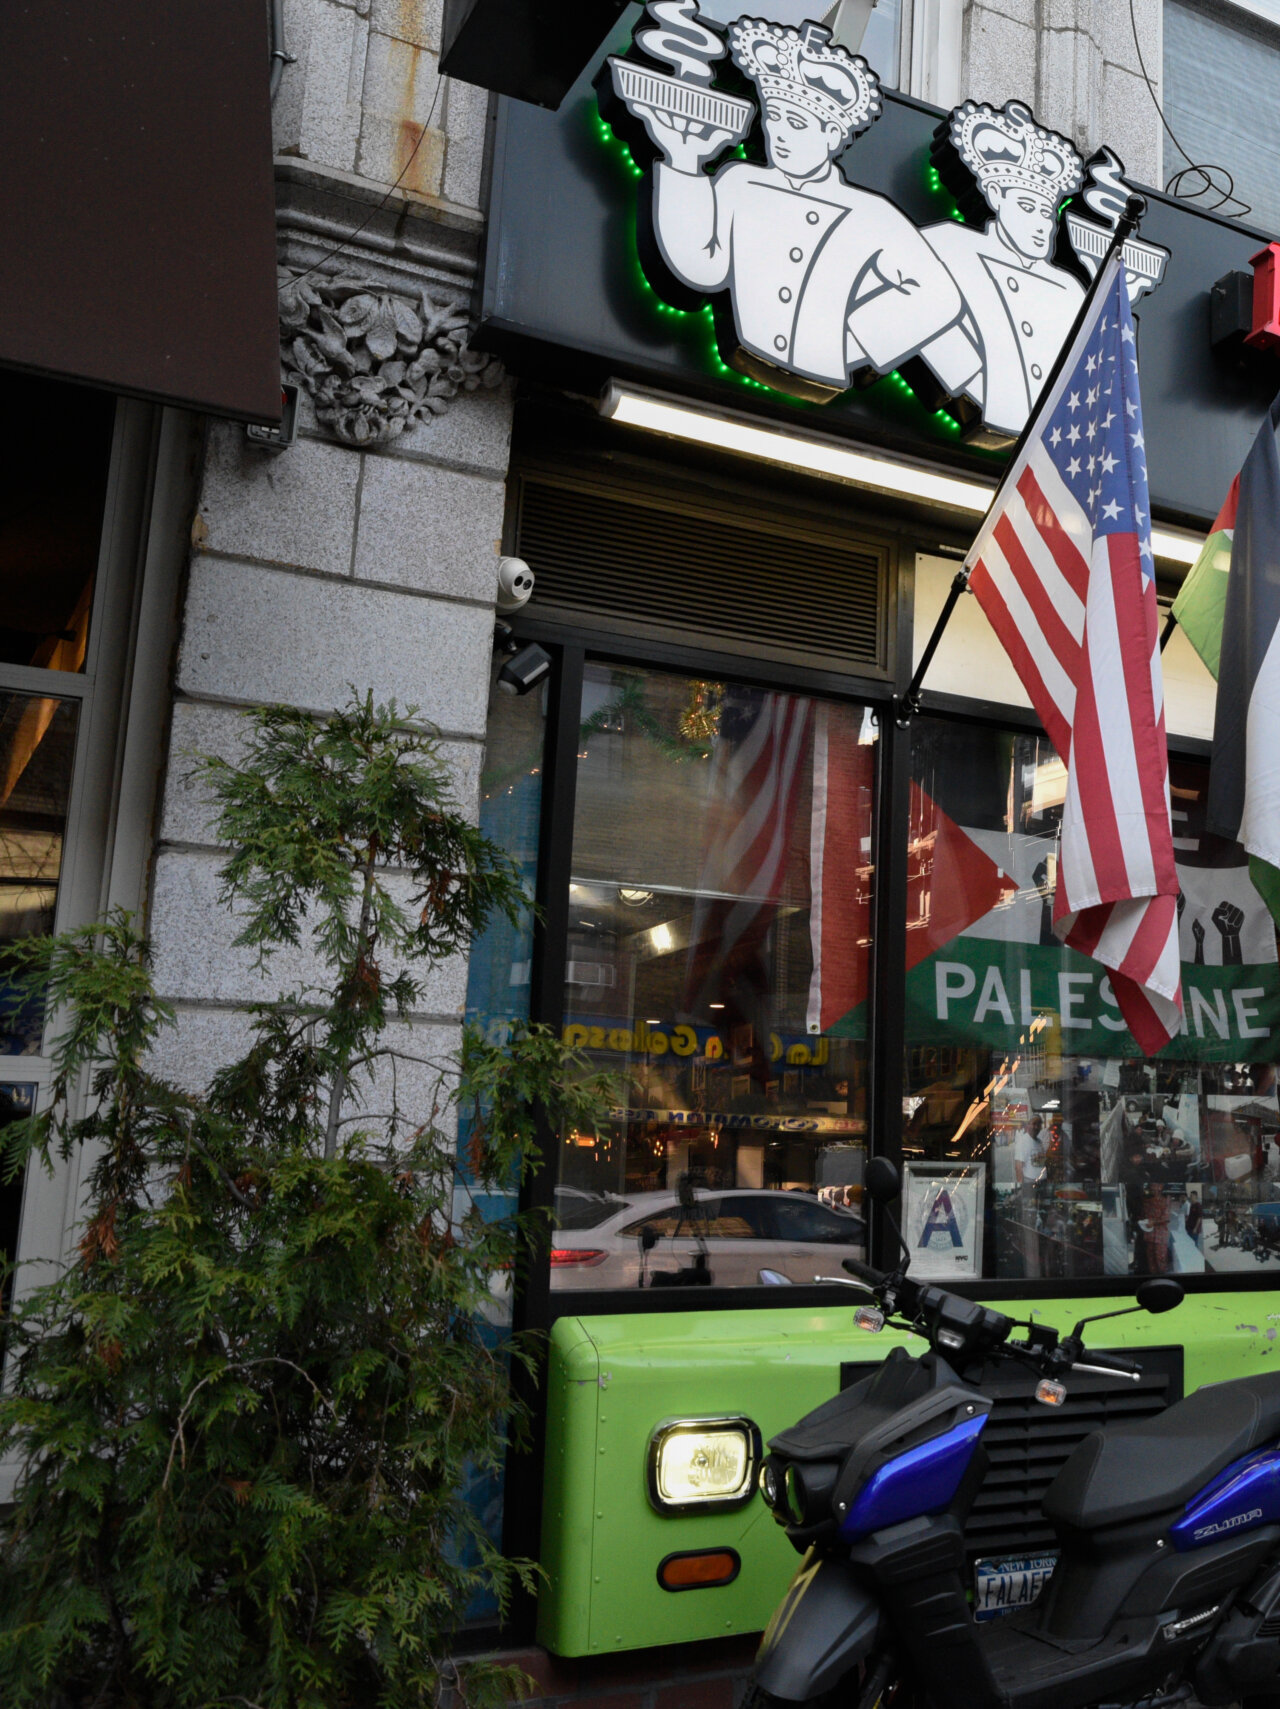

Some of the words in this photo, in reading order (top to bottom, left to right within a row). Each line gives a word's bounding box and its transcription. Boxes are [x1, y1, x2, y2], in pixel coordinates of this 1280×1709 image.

[935, 960, 1271, 1040] PALESNE
[917, 1189, 964, 1249] A
[1193, 1508, 1263, 1541] ZUMA
[1000, 1561, 1026, 1573] NEW
